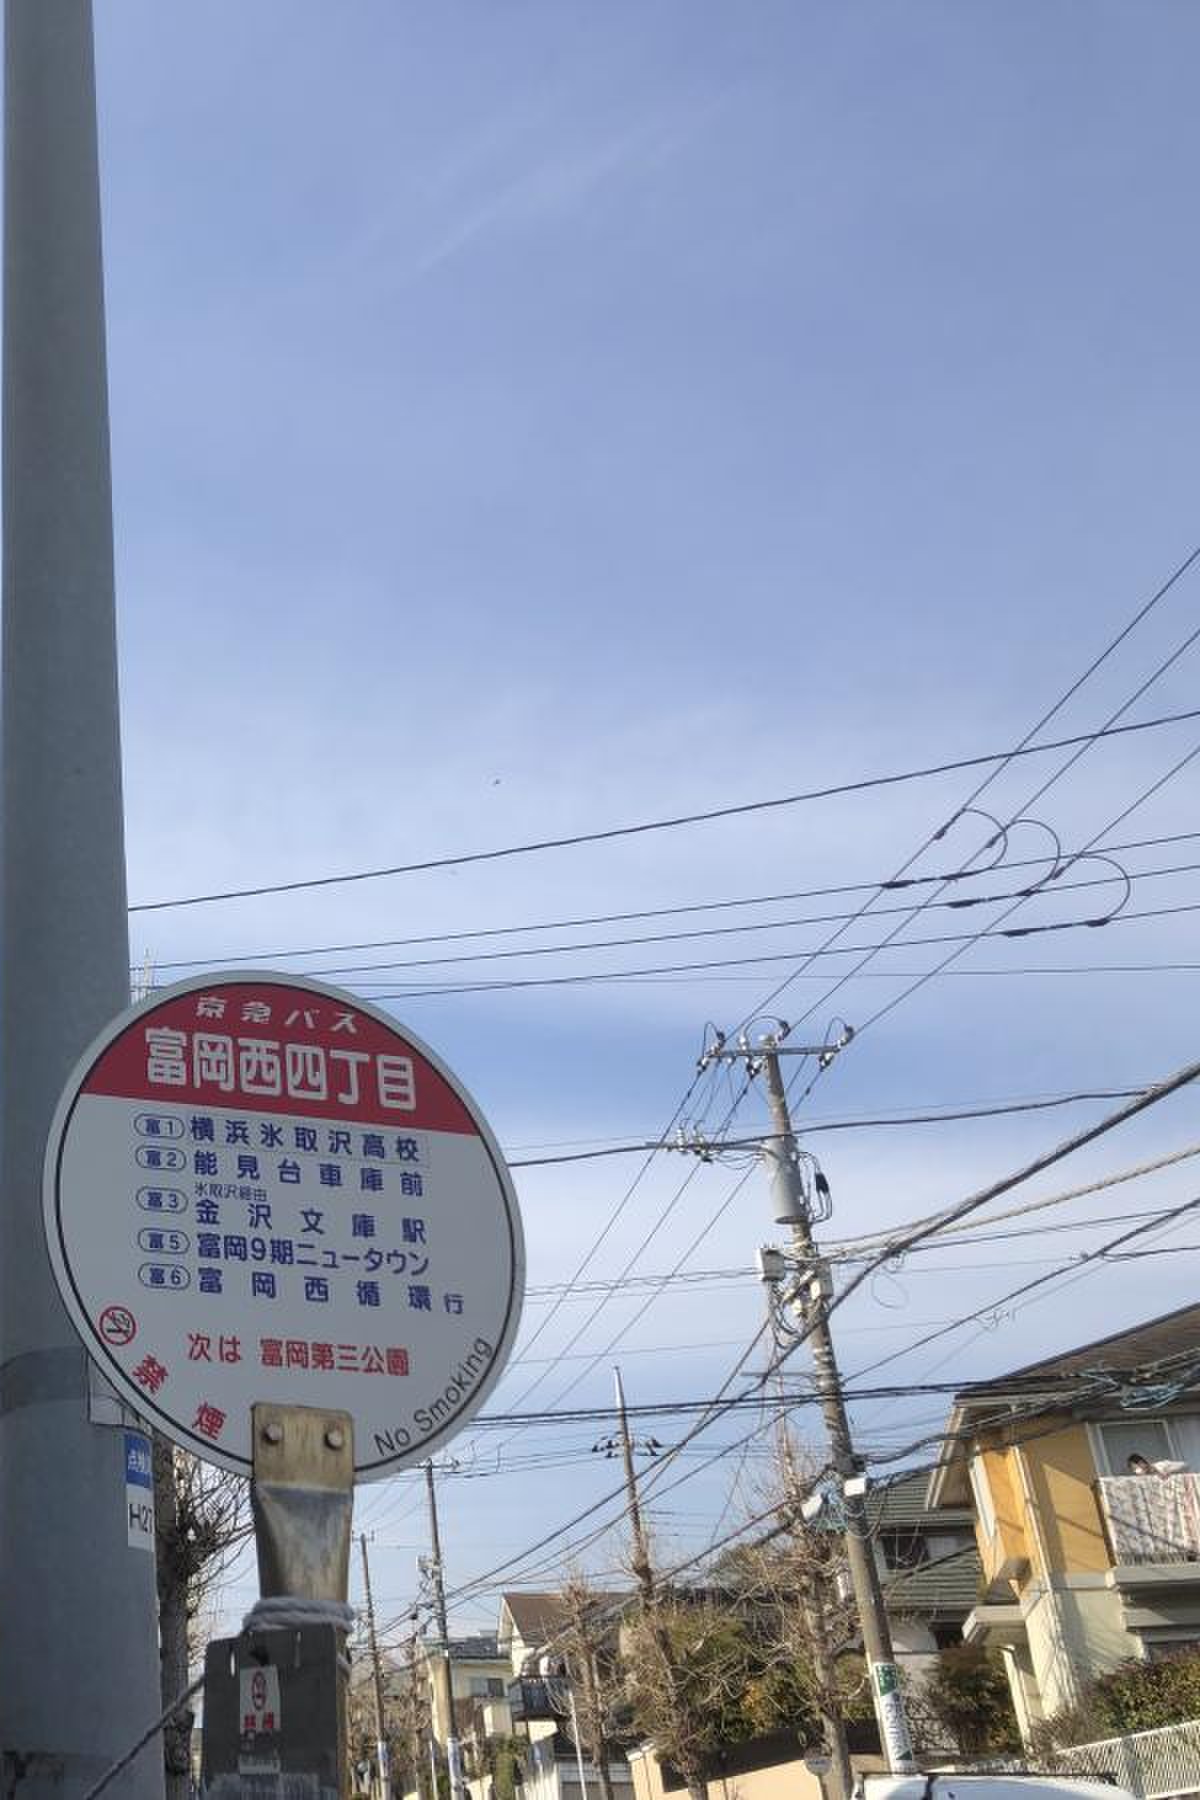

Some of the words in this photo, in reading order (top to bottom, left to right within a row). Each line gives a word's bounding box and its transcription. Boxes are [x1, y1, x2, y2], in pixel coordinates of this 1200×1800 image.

[195, 996, 358, 1034] 京急バス
[144, 1026, 417, 1111] 富岡西四丁目
[190, 1115, 420, 1163] 横浜氷取沢高校
[194, 1150, 424, 1197] 能見台車庫前
[195, 1199, 427, 1245] 金沢文庫駅
[197, 1233, 429, 1277] 富岡9期ニュータウン
[188, 1333, 243, 1363] 次は
[260, 1338, 410, 1377] 富岡第三公園
[373, 1428, 411, 1457] No
[413, 1336, 494, 1432] Smoking
